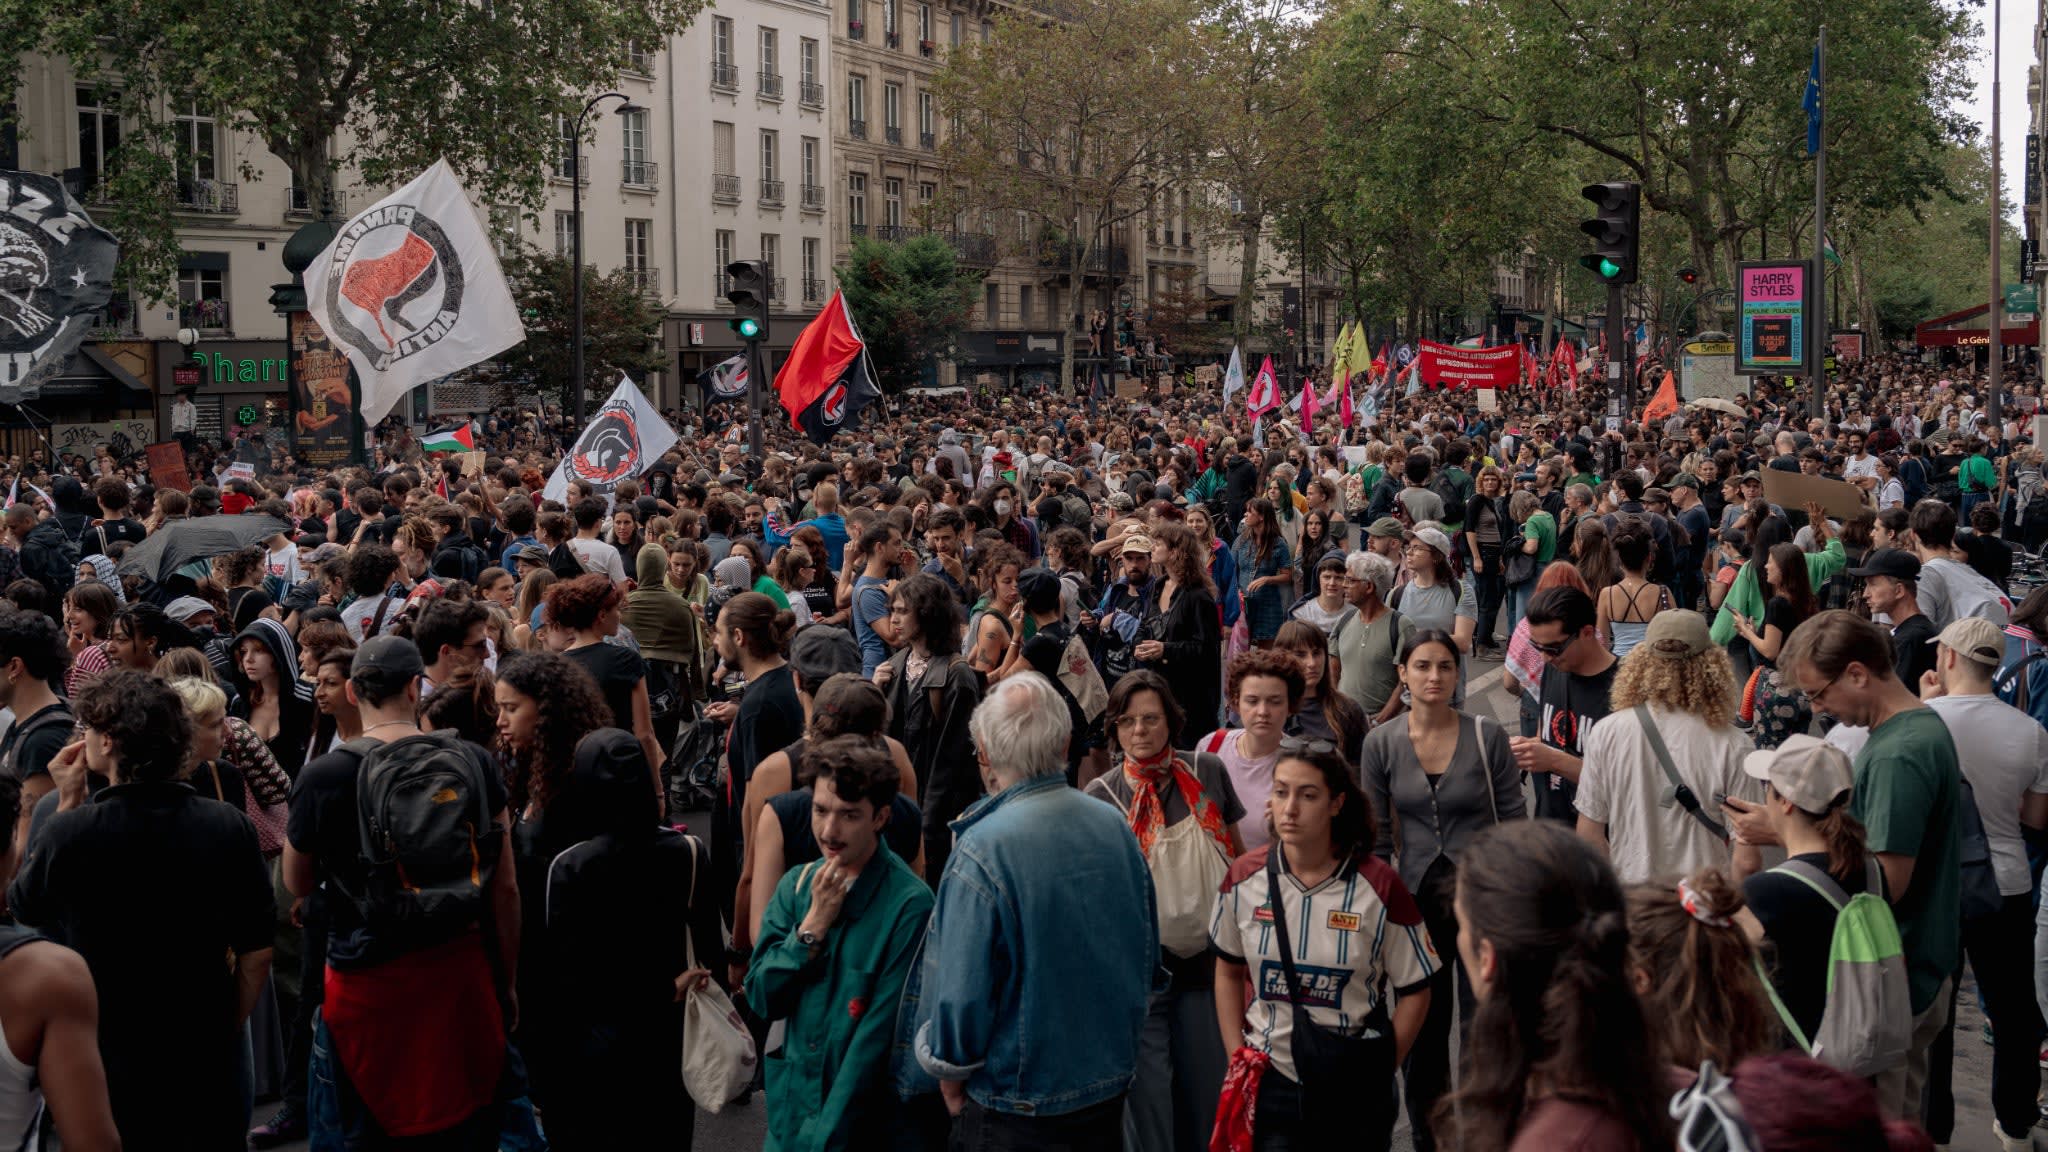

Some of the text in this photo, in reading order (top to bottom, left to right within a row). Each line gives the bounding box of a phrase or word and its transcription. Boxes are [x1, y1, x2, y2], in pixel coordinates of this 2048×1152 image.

[1753, 274, 1792, 285] HARRY
[1751, 285, 1794, 296] STYLES
[1957, 336, 1990, 345] Le Géni
[1315, 974, 1343, 991] DE
